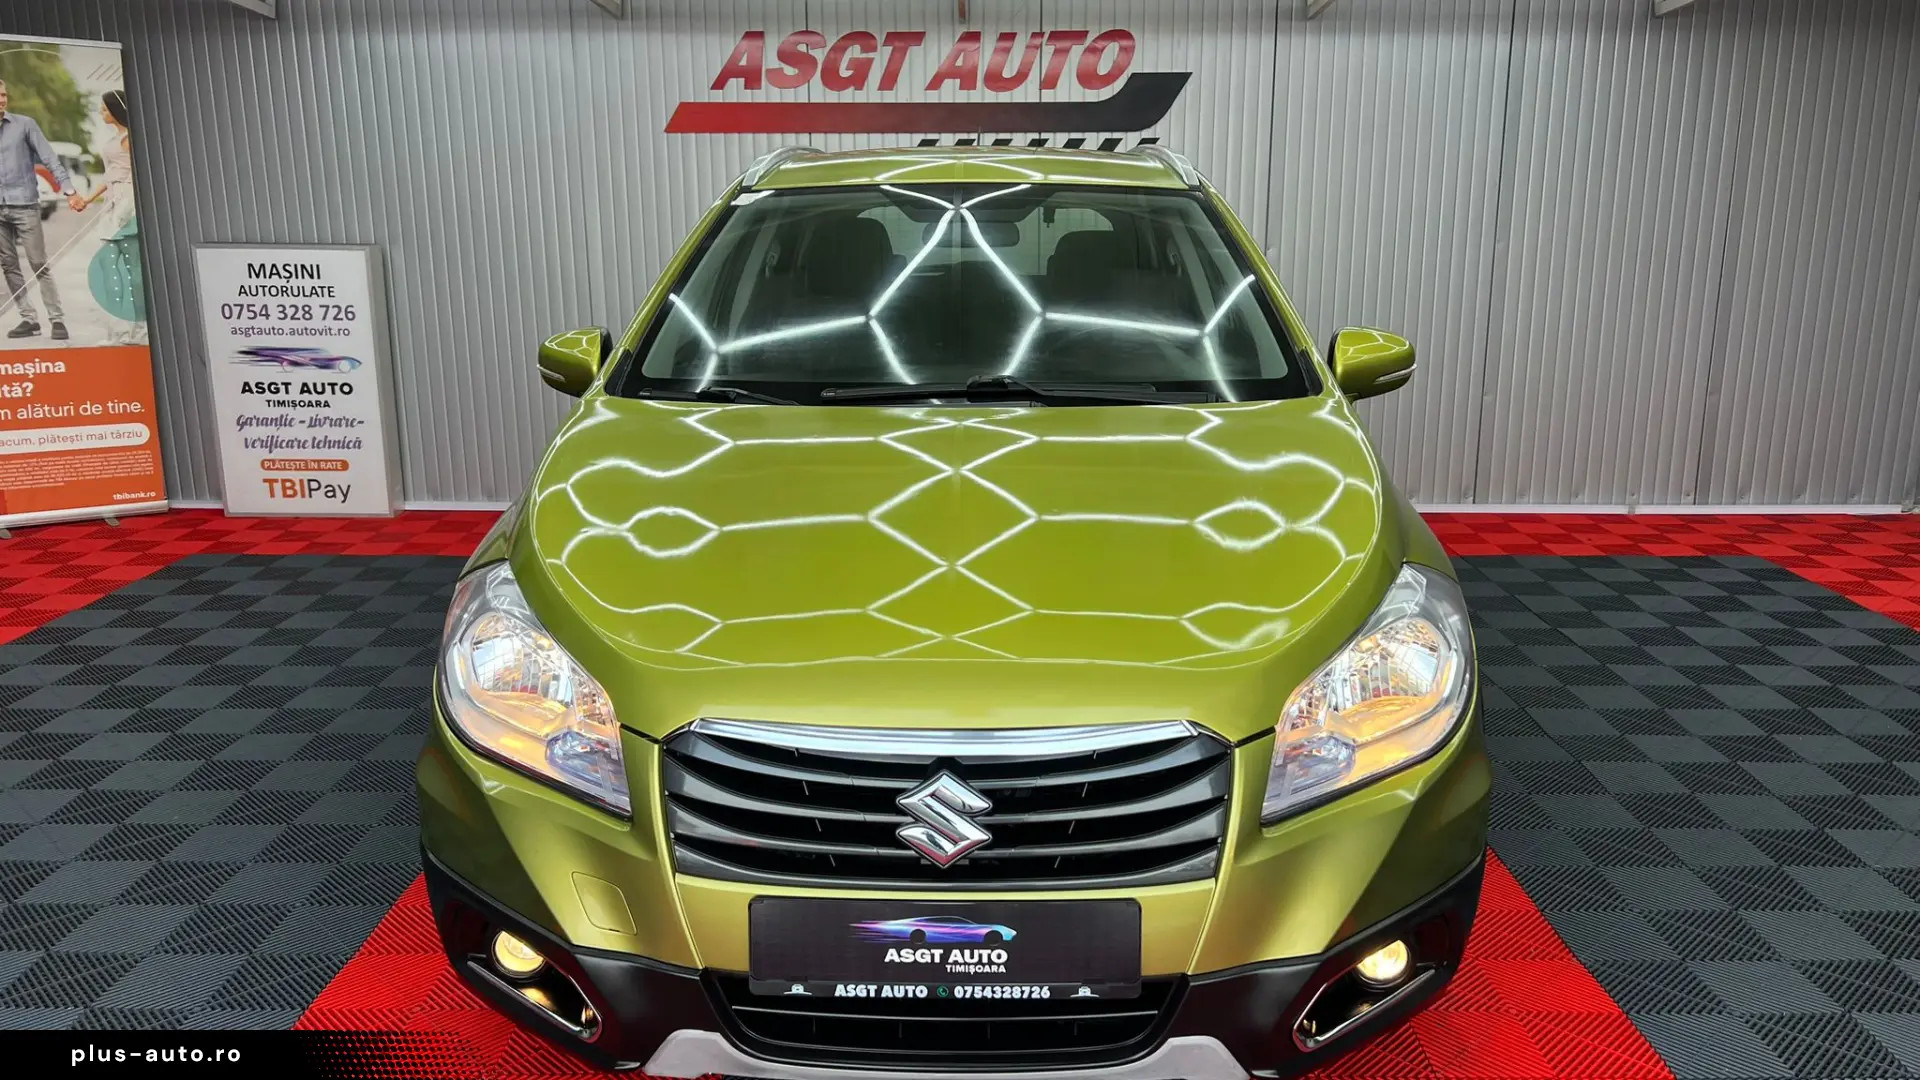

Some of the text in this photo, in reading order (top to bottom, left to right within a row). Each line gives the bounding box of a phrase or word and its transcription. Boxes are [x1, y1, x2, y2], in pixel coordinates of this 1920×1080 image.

[710, 29, 1137, 92] ASGT AUTO
[247, 263, 321, 283] MAȘINI
[238, 285, 336, 298] AUTORULATE
[221, 303, 356, 321] 0754 328 726
[231, 325, 350, 337] asgtauto.autovit.ro
[241, 381, 354, 395] ASGT AUTO
[16, 401, 74, 419] alături
[79, 400, 103, 416] de
[106, 399, 145, 414] tine.
[265, 399, 331, 410] TIMIȘOARA
[86, 432, 107, 442] mai
[320, 461, 343, 470] RATE
[112, 491, 156, 500] tbibank.ro
[262, 478, 351, 504] TBIPay
[884, 948, 1008, 964] ASGT AUTO
[945, 964, 1006, 975] TIMIȘOARA
[834, 984, 1051, 999] ASGT AUTO 0754328726
